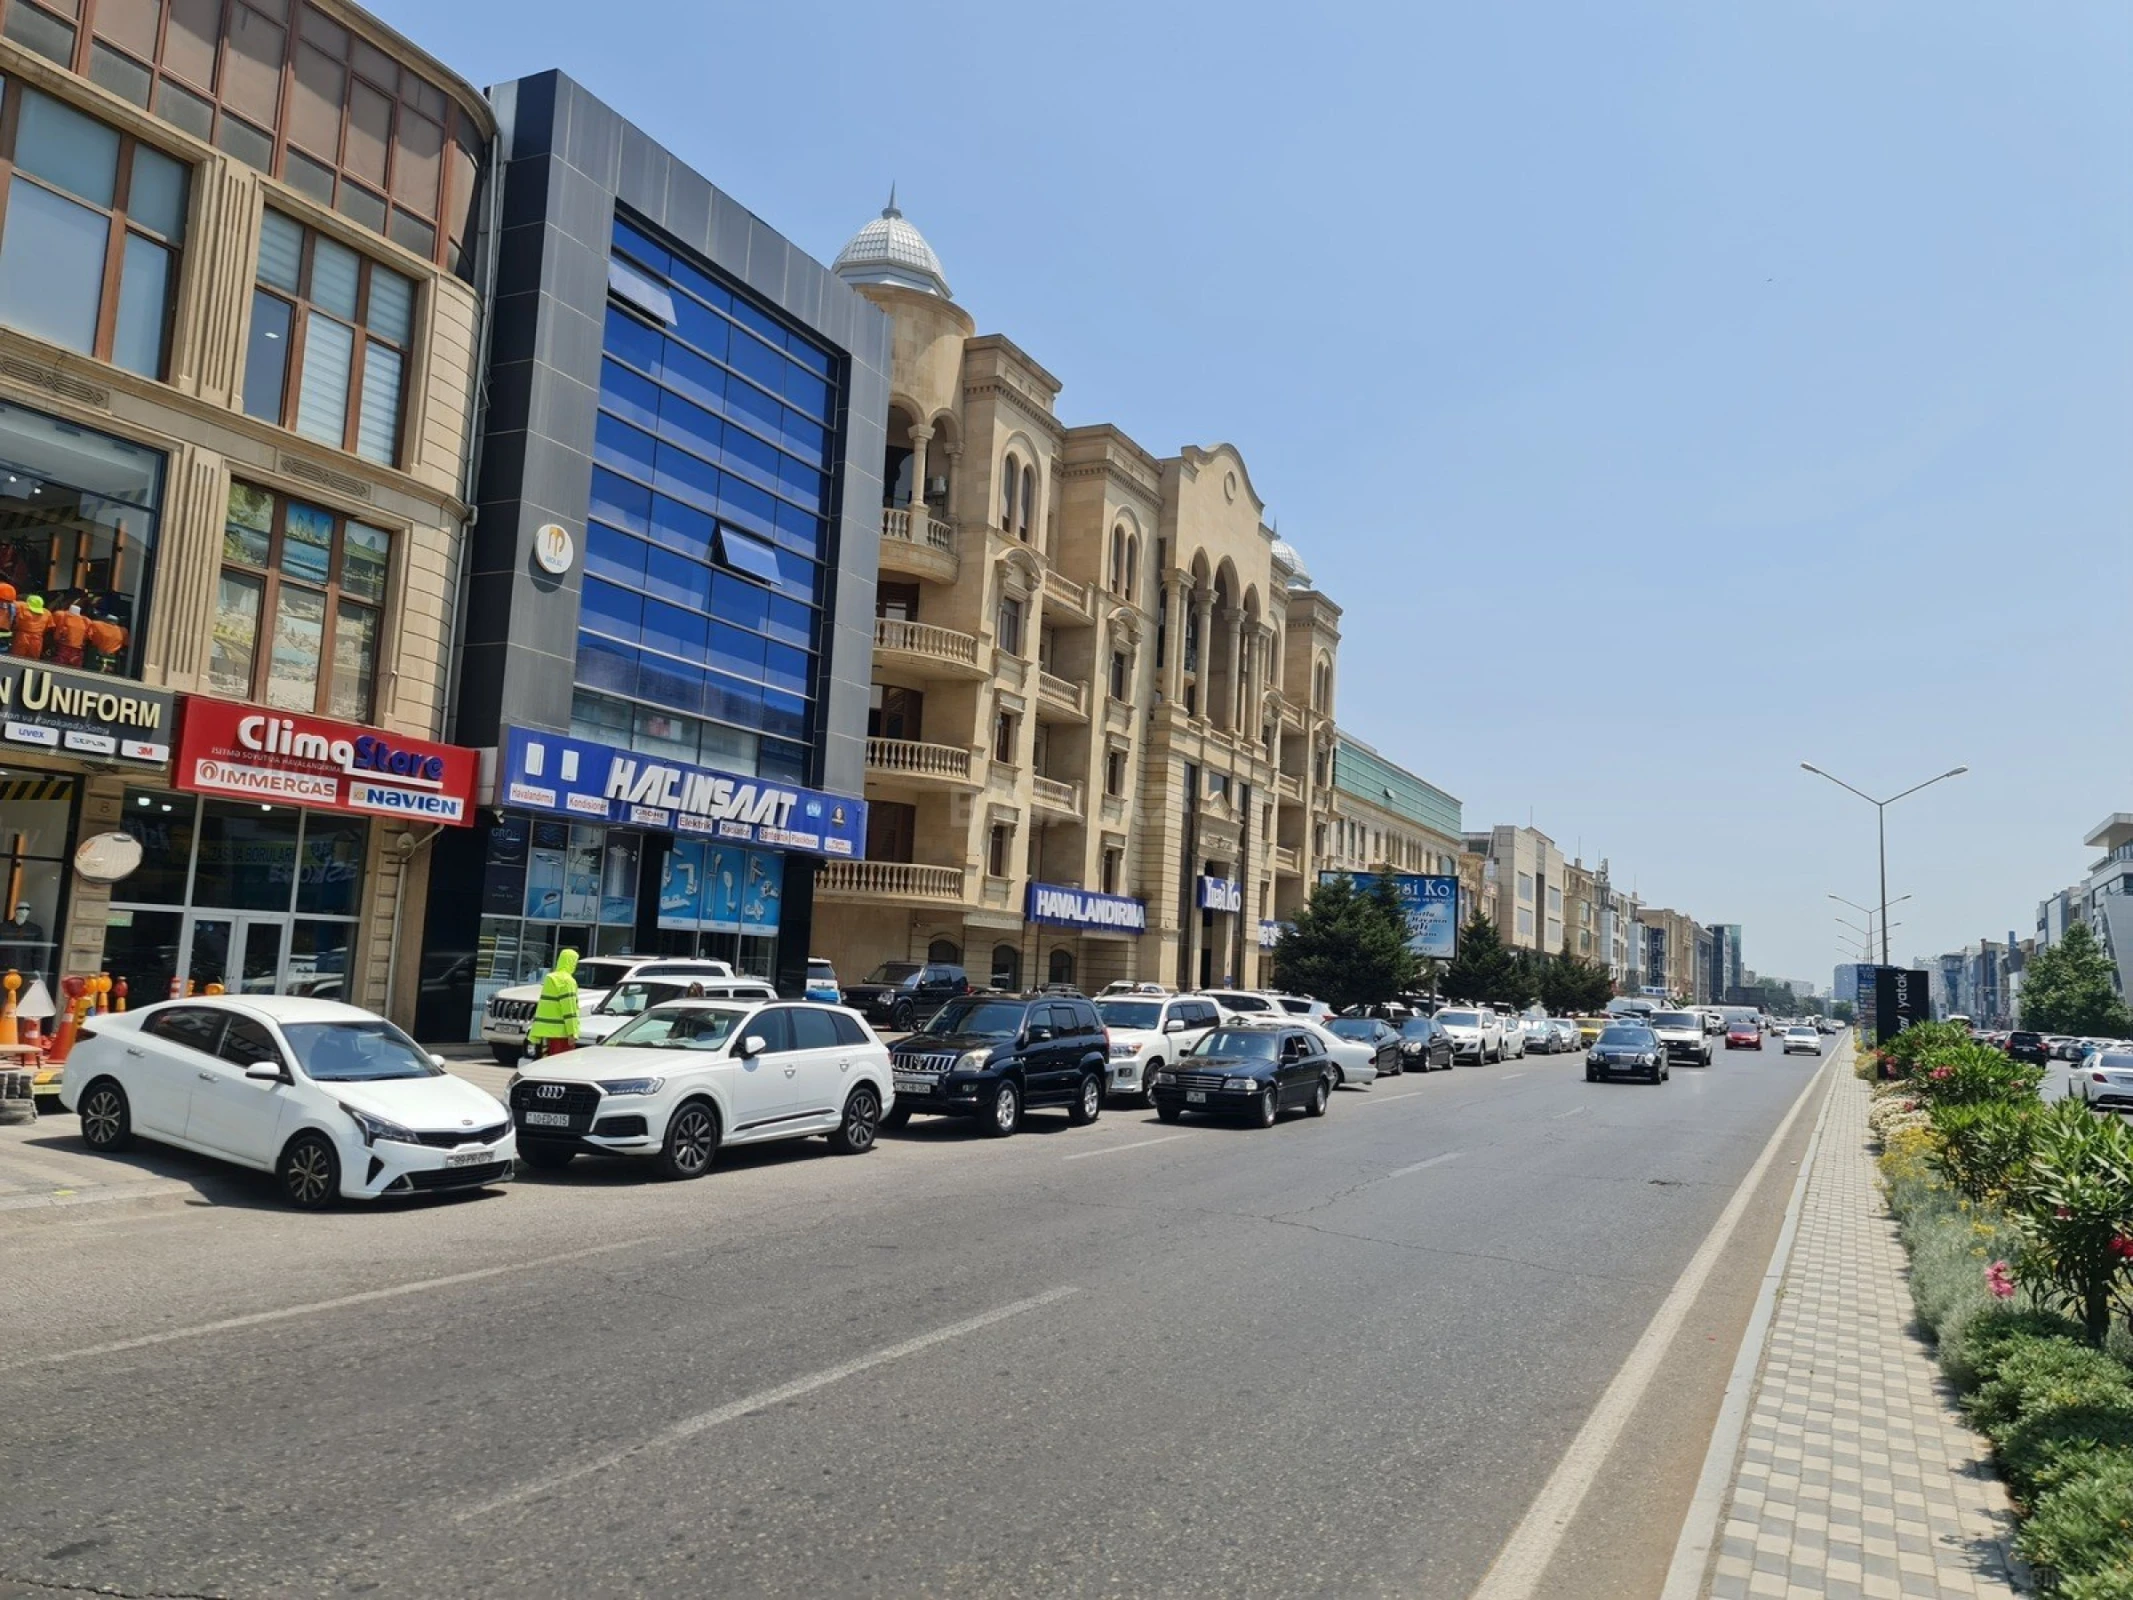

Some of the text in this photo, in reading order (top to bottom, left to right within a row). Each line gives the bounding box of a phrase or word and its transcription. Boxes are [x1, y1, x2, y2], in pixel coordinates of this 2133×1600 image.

[22, 668, 161, 729] UNIFORM
[18, 728, 45, 739] uvex
[137, 746, 153, 757] 3M
[220, 768, 336, 797] IMMERGAS
[679, 817, 712, 830] Elektrik
[1424, 879, 1450, 897] Ko
[1036, 889, 1145, 929] HAVALANDIRMA
[1894, 973, 1911, 1008] yatak
